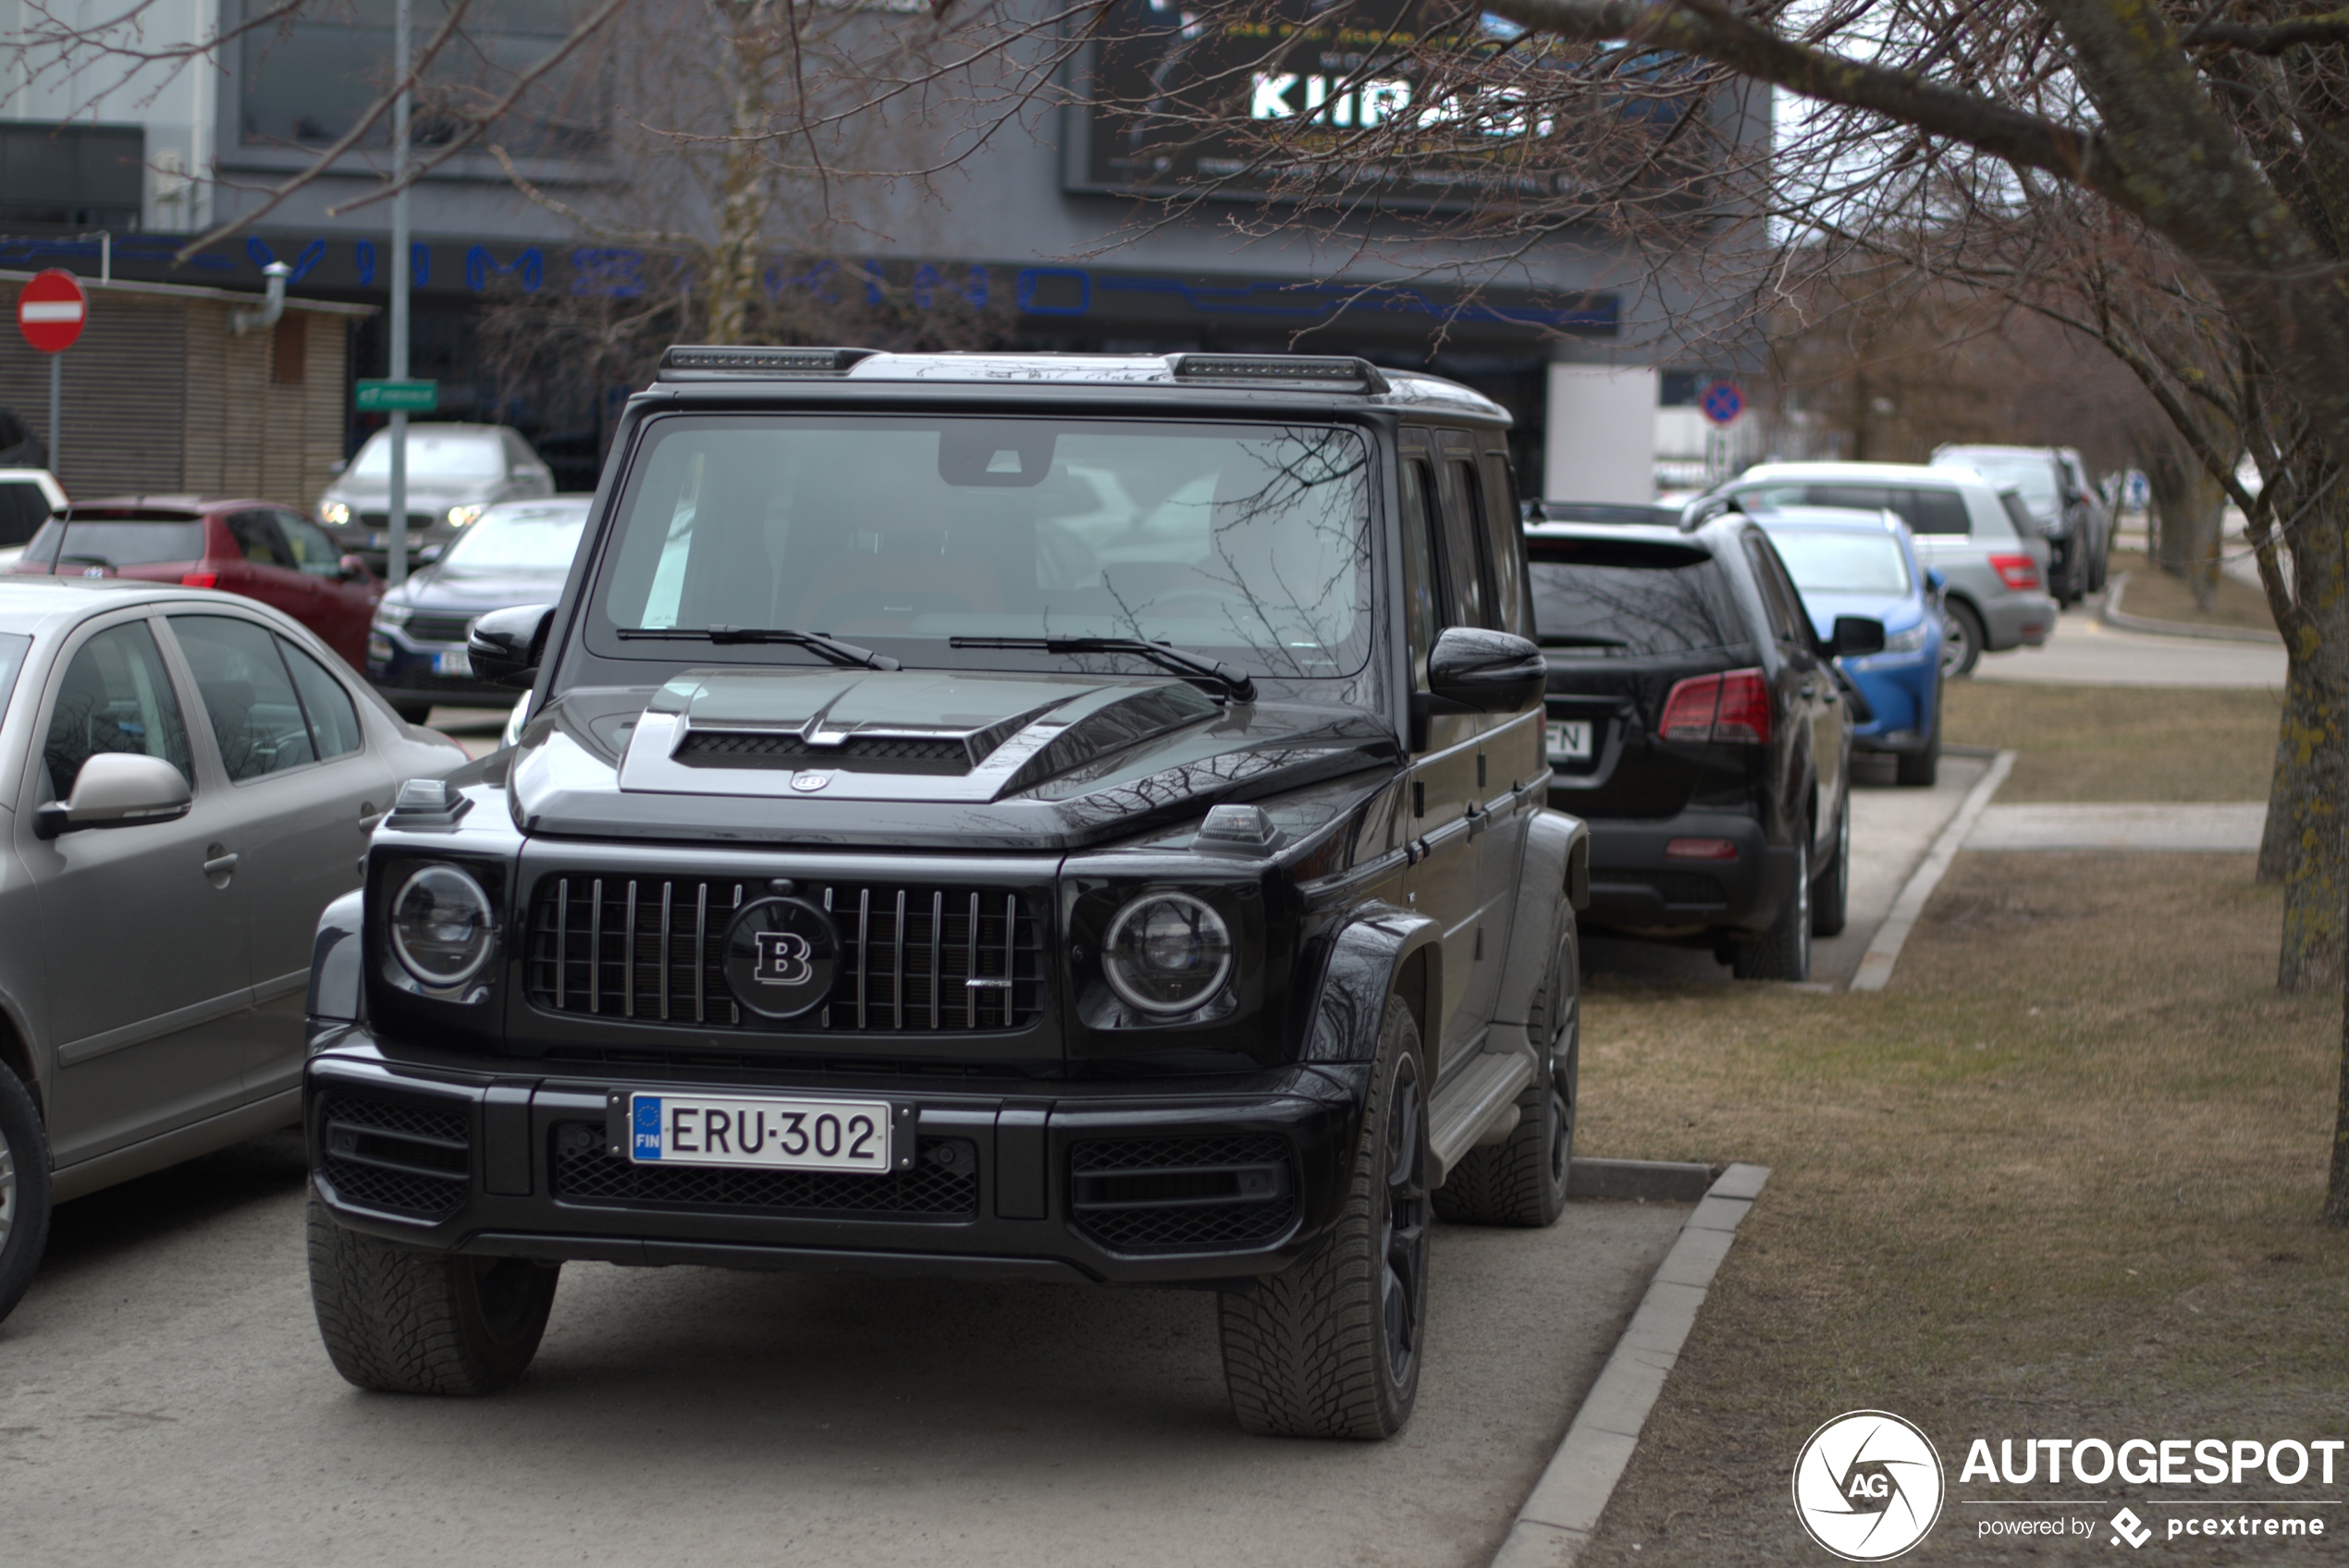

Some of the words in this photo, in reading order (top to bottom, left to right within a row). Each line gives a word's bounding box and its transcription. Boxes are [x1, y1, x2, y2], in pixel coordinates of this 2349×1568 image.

[754, 931, 813, 986] B
[636, 1133, 660, 1148] FIN
[671, 1107, 875, 1159] ERU-302
